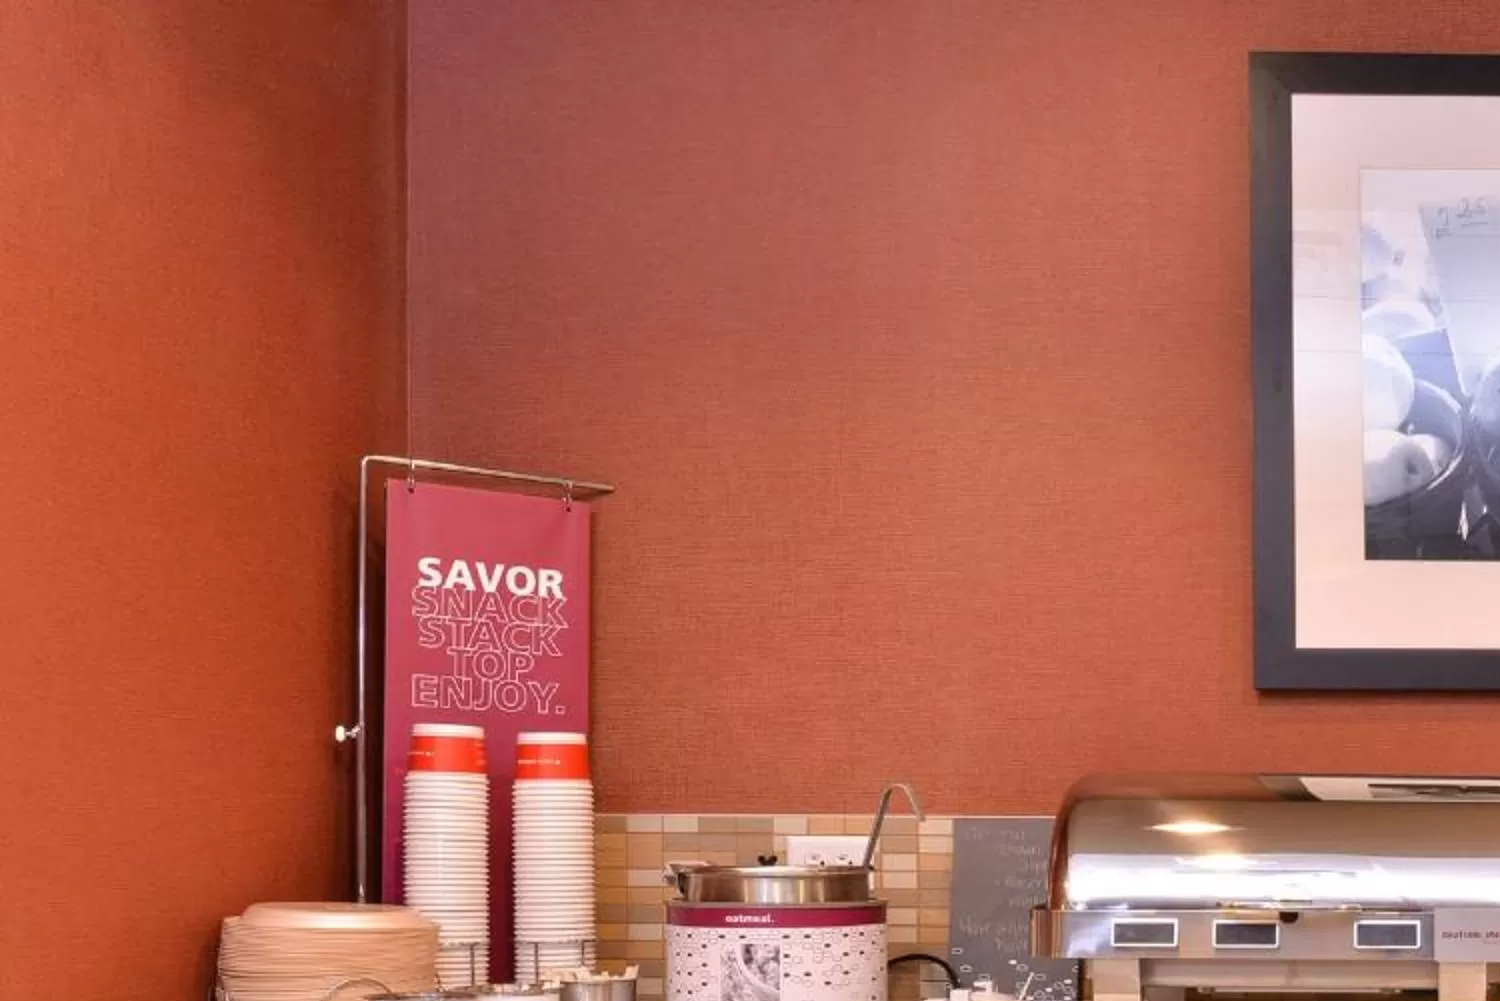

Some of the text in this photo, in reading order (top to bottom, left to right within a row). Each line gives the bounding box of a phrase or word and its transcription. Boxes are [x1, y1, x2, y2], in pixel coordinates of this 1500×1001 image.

[417, 557, 564, 600] SAVOR
[411, 585, 569, 629] SNACK
[417, 615, 564, 657] STACK
[446, 647, 535, 683] TOP
[411, 673, 566, 715] ENJOY.
